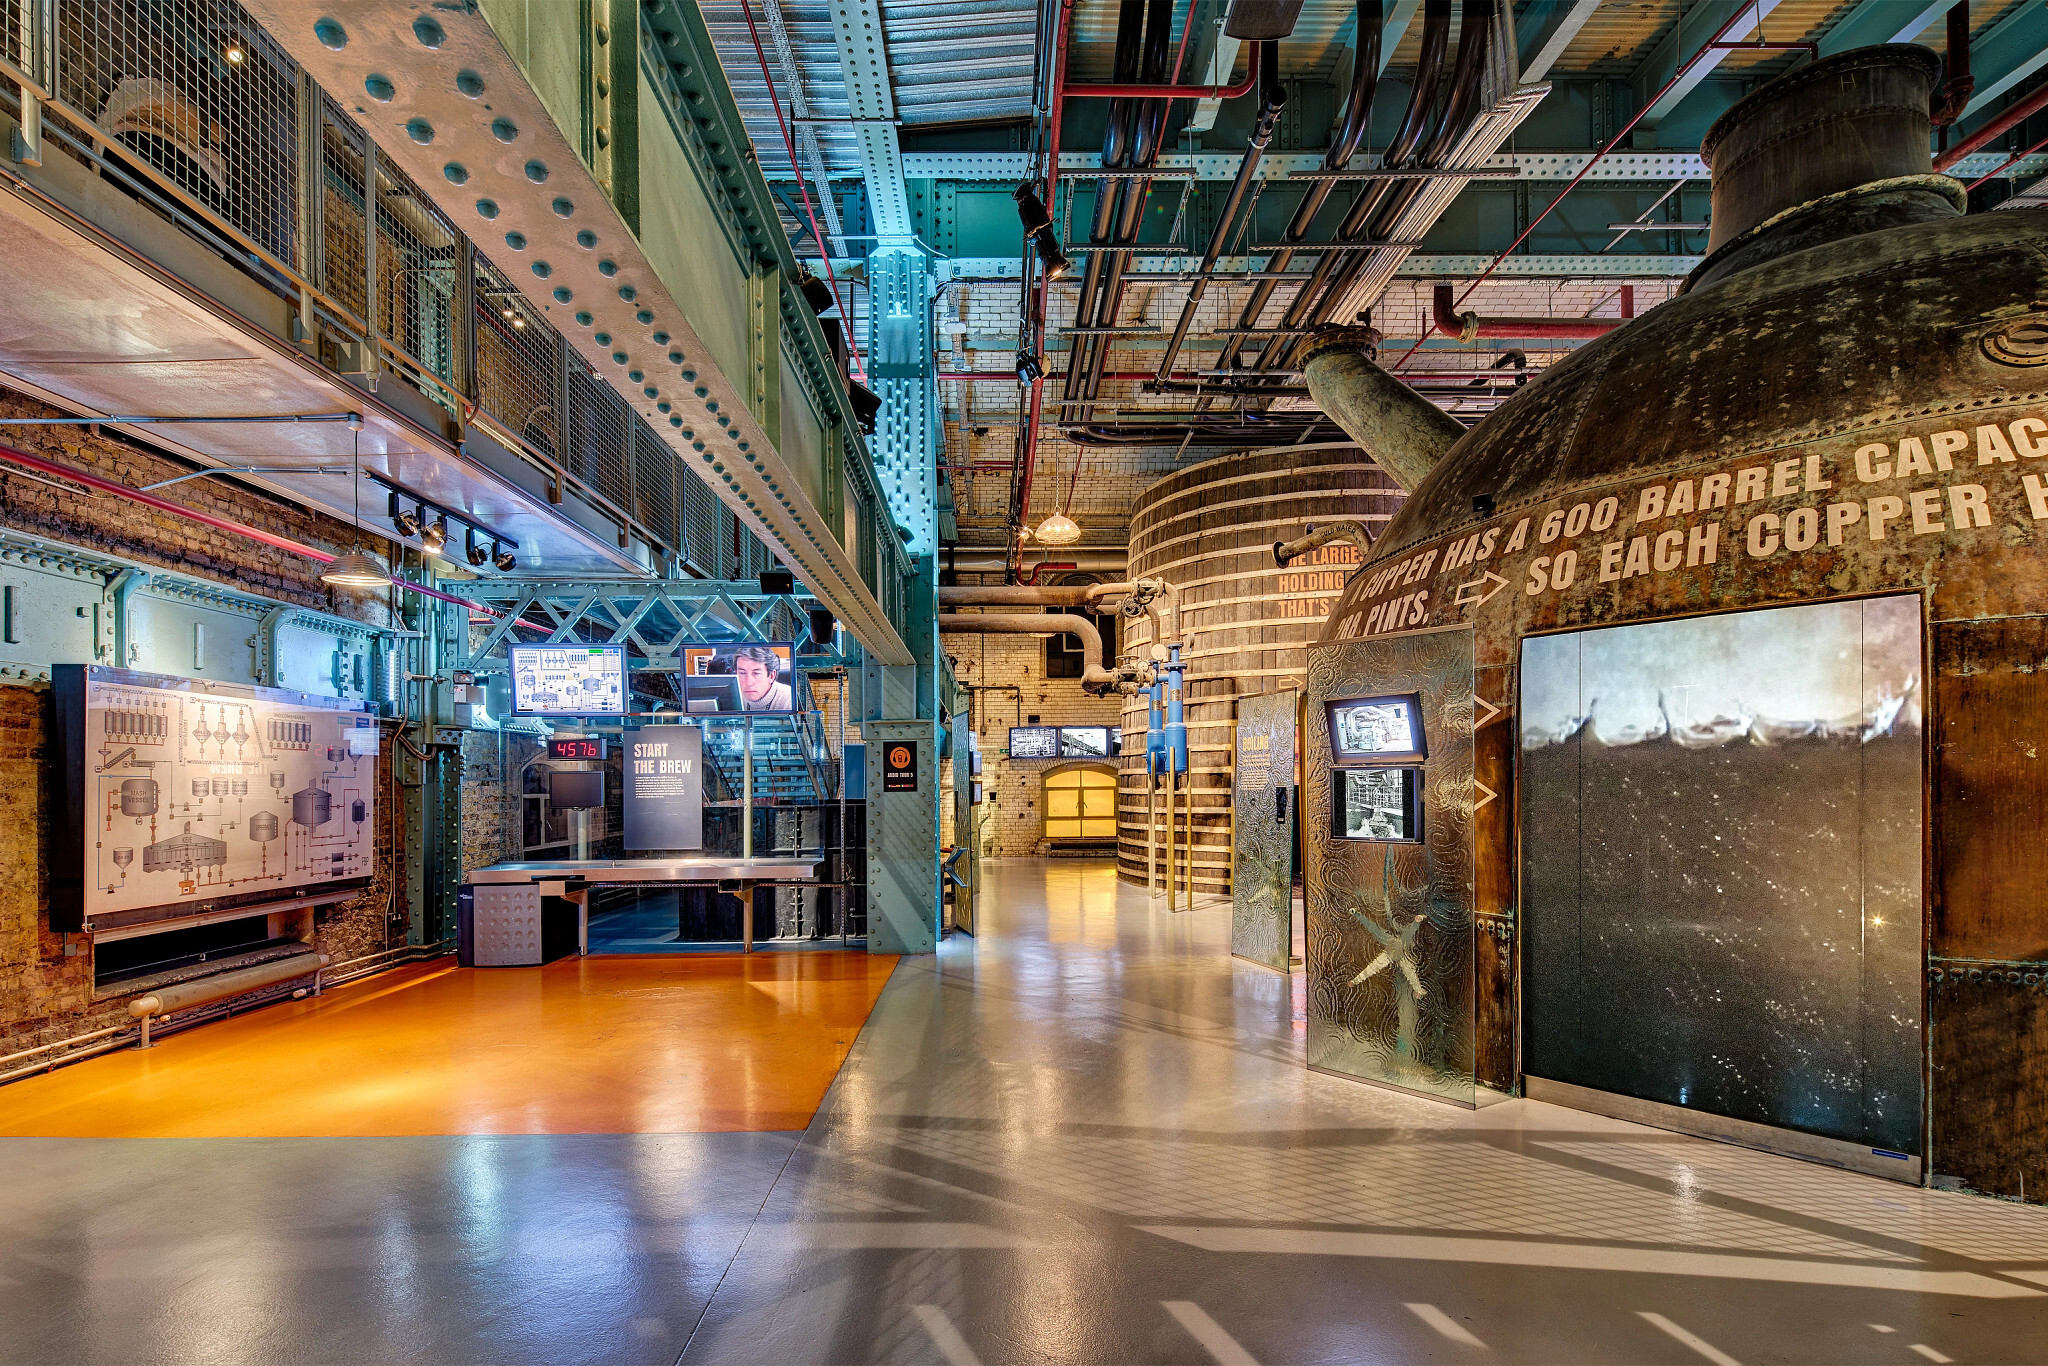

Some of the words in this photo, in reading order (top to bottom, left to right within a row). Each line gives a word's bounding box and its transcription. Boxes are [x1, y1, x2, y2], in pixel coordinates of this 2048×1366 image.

[1359, 549, 1438, 602] COPPER
[1440, 526, 1501, 574] HAS
[1503, 517, 1531, 554] A
[1538, 496, 1619, 545] 600
[1635, 454, 1833, 523] BARREL
[1854, 417, 2048, 483] CAPAC
[1312, 546, 1364, 565] LARGE
[1363, 590, 1430, 637] PINTS,
[1526, 550, 1578, 596] SO
[1599, 522, 1720, 583] EACH
[1747, 483, 1992, 557] COPPER
[1279, 571, 1345, 593] HOLDING
[1279, 598, 1330, 618] THAT'S
[557, 742, 597, 757] 4576
[634, 743, 669, 758] START
[633, 759, 655, 774] THE
[659, 759, 692, 774] BREW
